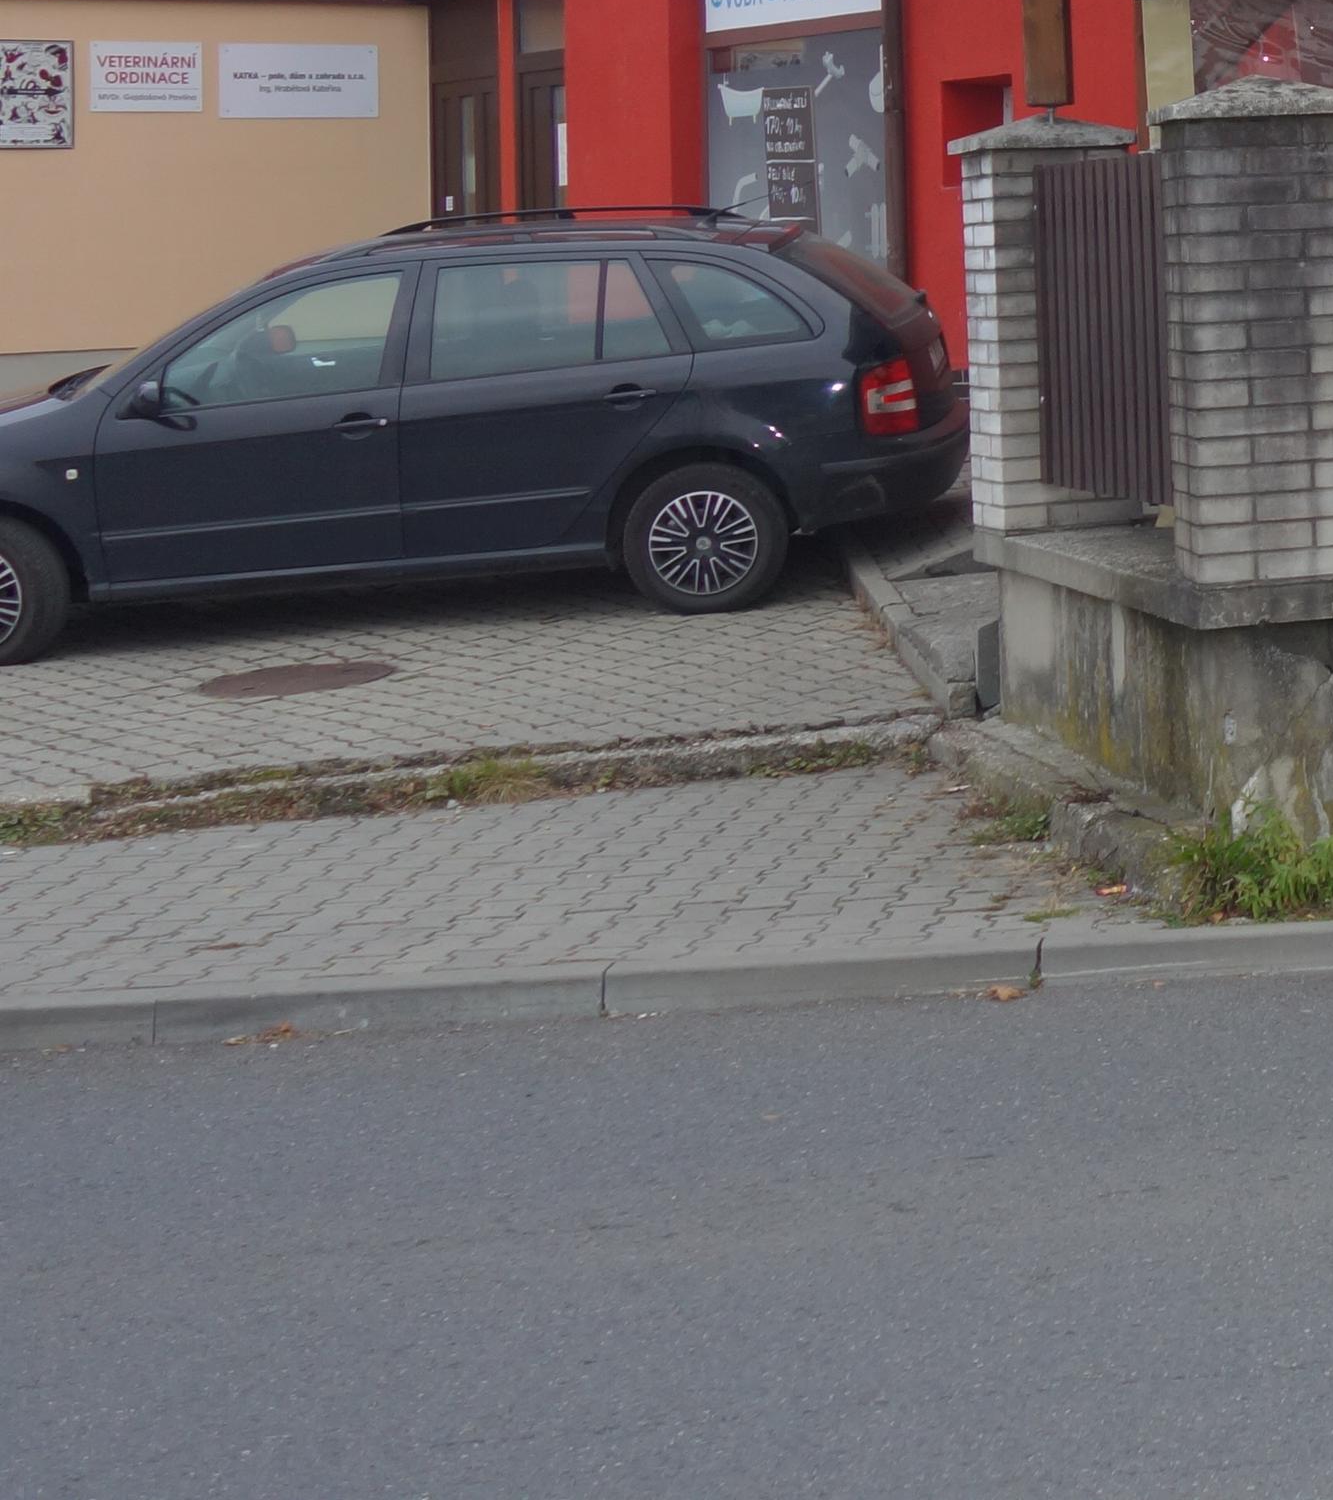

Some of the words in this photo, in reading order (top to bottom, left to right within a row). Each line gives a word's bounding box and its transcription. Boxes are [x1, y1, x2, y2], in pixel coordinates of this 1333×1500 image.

[97, 52, 197, 69] VETERINÁRNÍ
[105, 71, 189, 85] ORDINACE
[233, 72, 259, 80] KATKA
